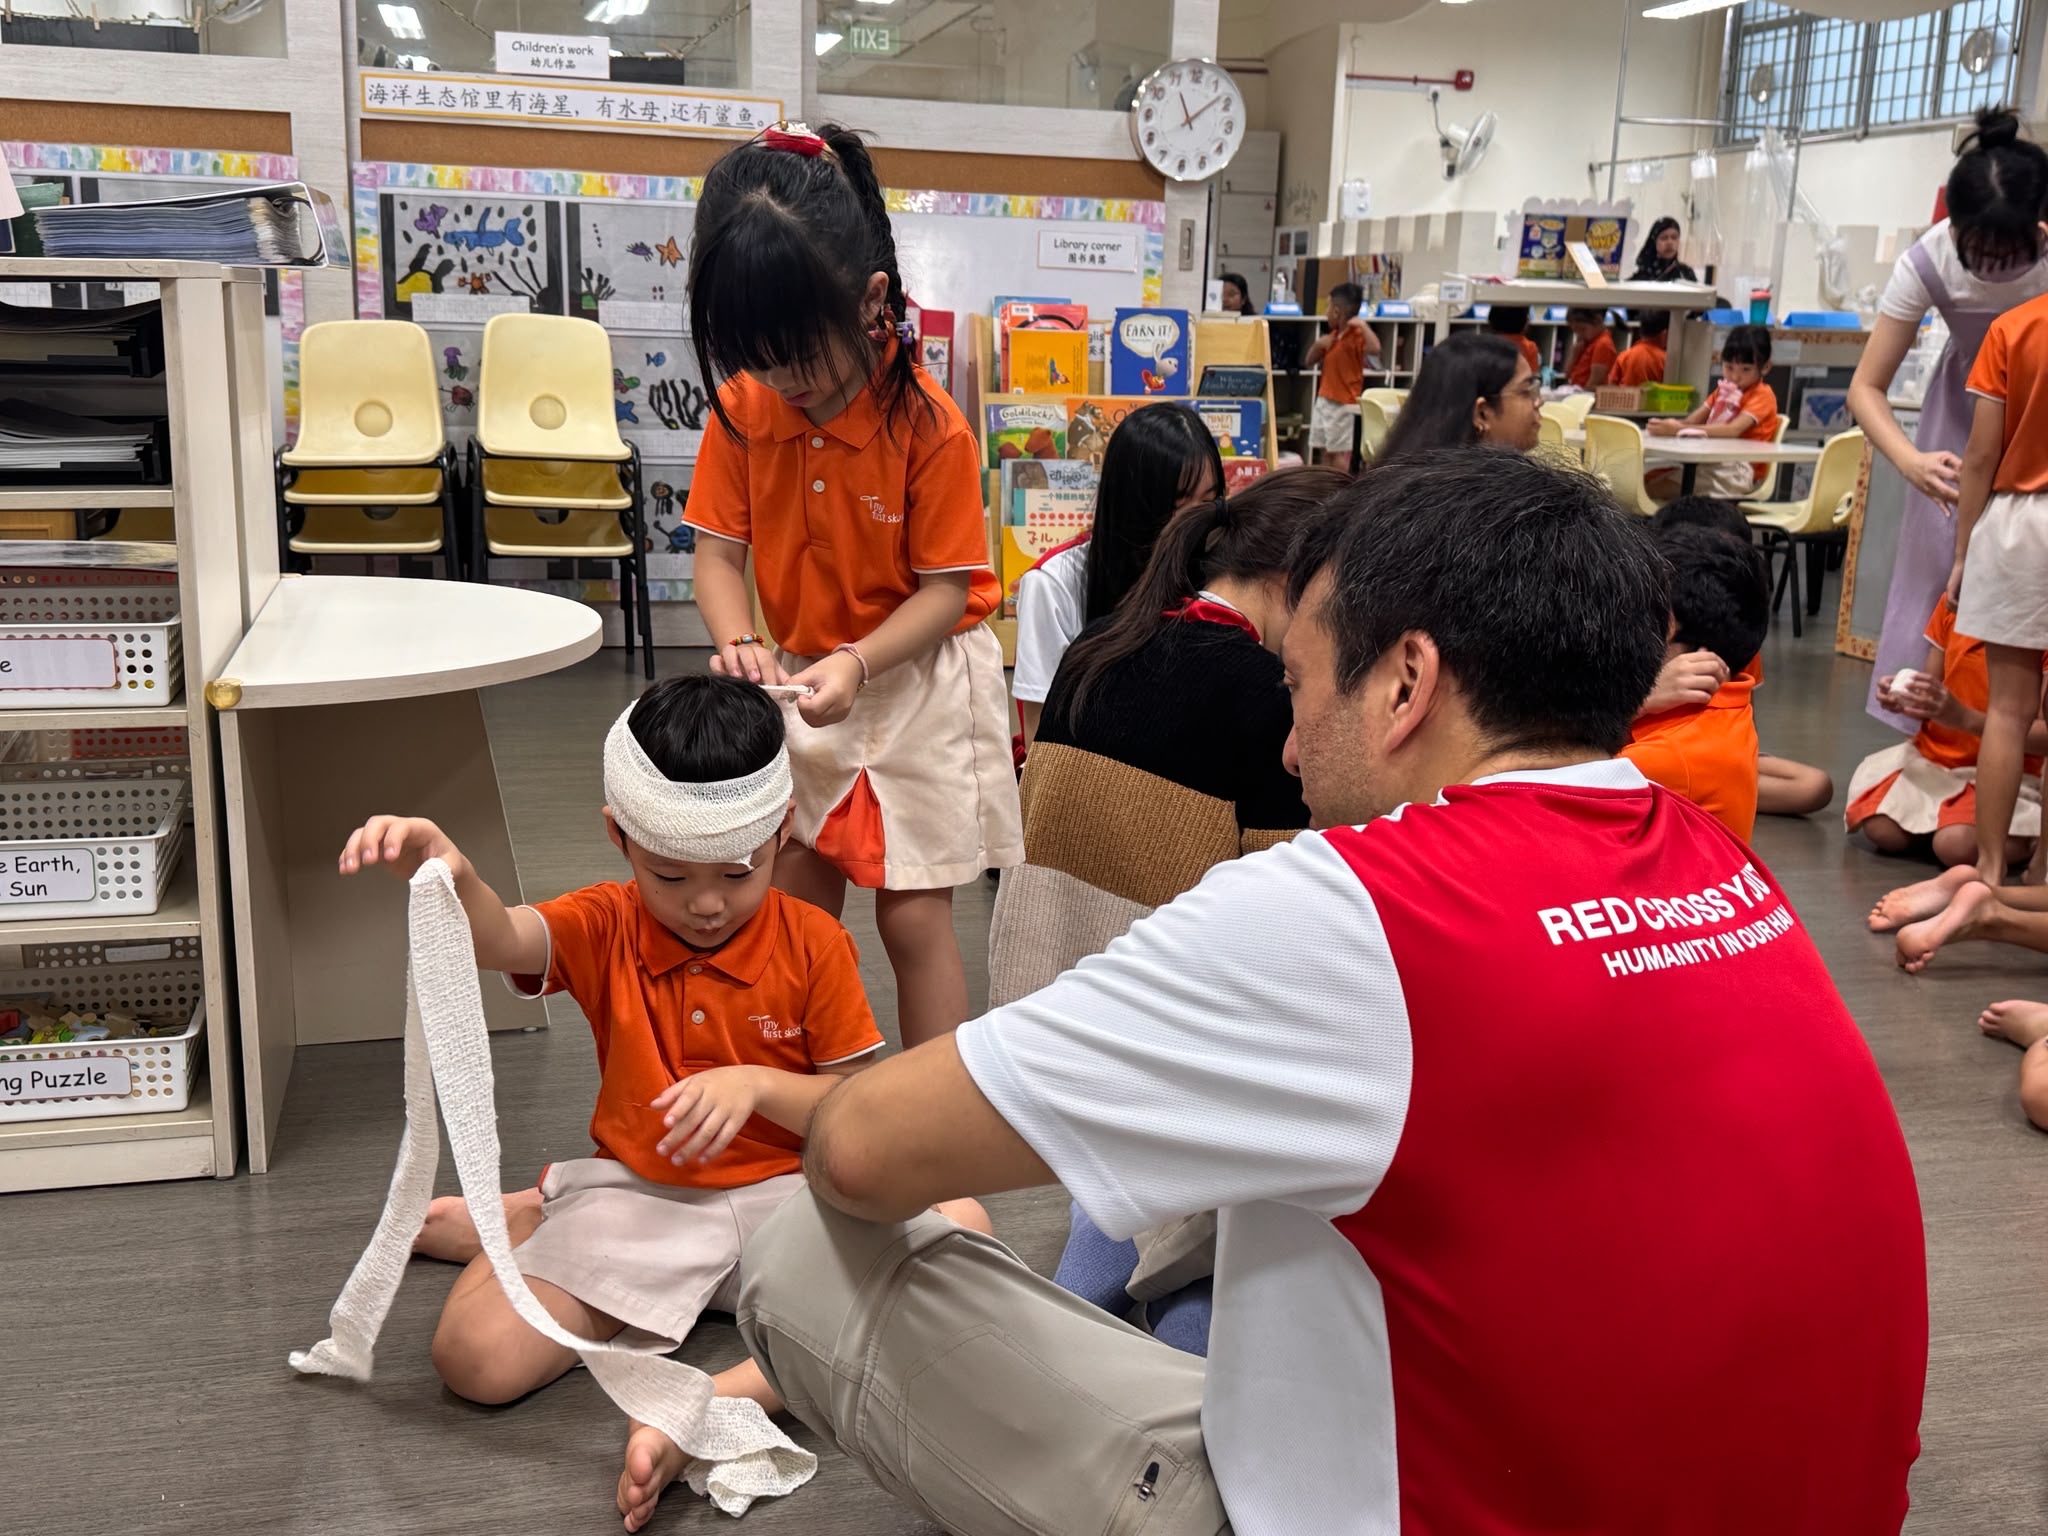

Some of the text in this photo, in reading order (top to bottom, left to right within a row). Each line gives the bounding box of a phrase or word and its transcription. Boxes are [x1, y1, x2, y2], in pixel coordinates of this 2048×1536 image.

[511, 40, 594, 56] Children's work
[530, 57, 576, 70] 幼儿作品
[1222, 96, 1233, 112] 2
[1224, 120, 1234, 135] 3
[1053, 239, 1122, 251] Library corner
[1126, 324, 1172, 337] EARN IT!
[15, 855, 80, 874] Earth,
[10, 881, 48, 897] Sun
[1537, 897, 1638, 946] RED
[1634, 888, 1736, 931] CROSS
[1602, 935, 1723, 978] HUMANITY
[1717, 931, 1746, 956] IN
[1736, 920, 1778, 949] OUR
[31, 1067, 107, 1088] Puzzle
